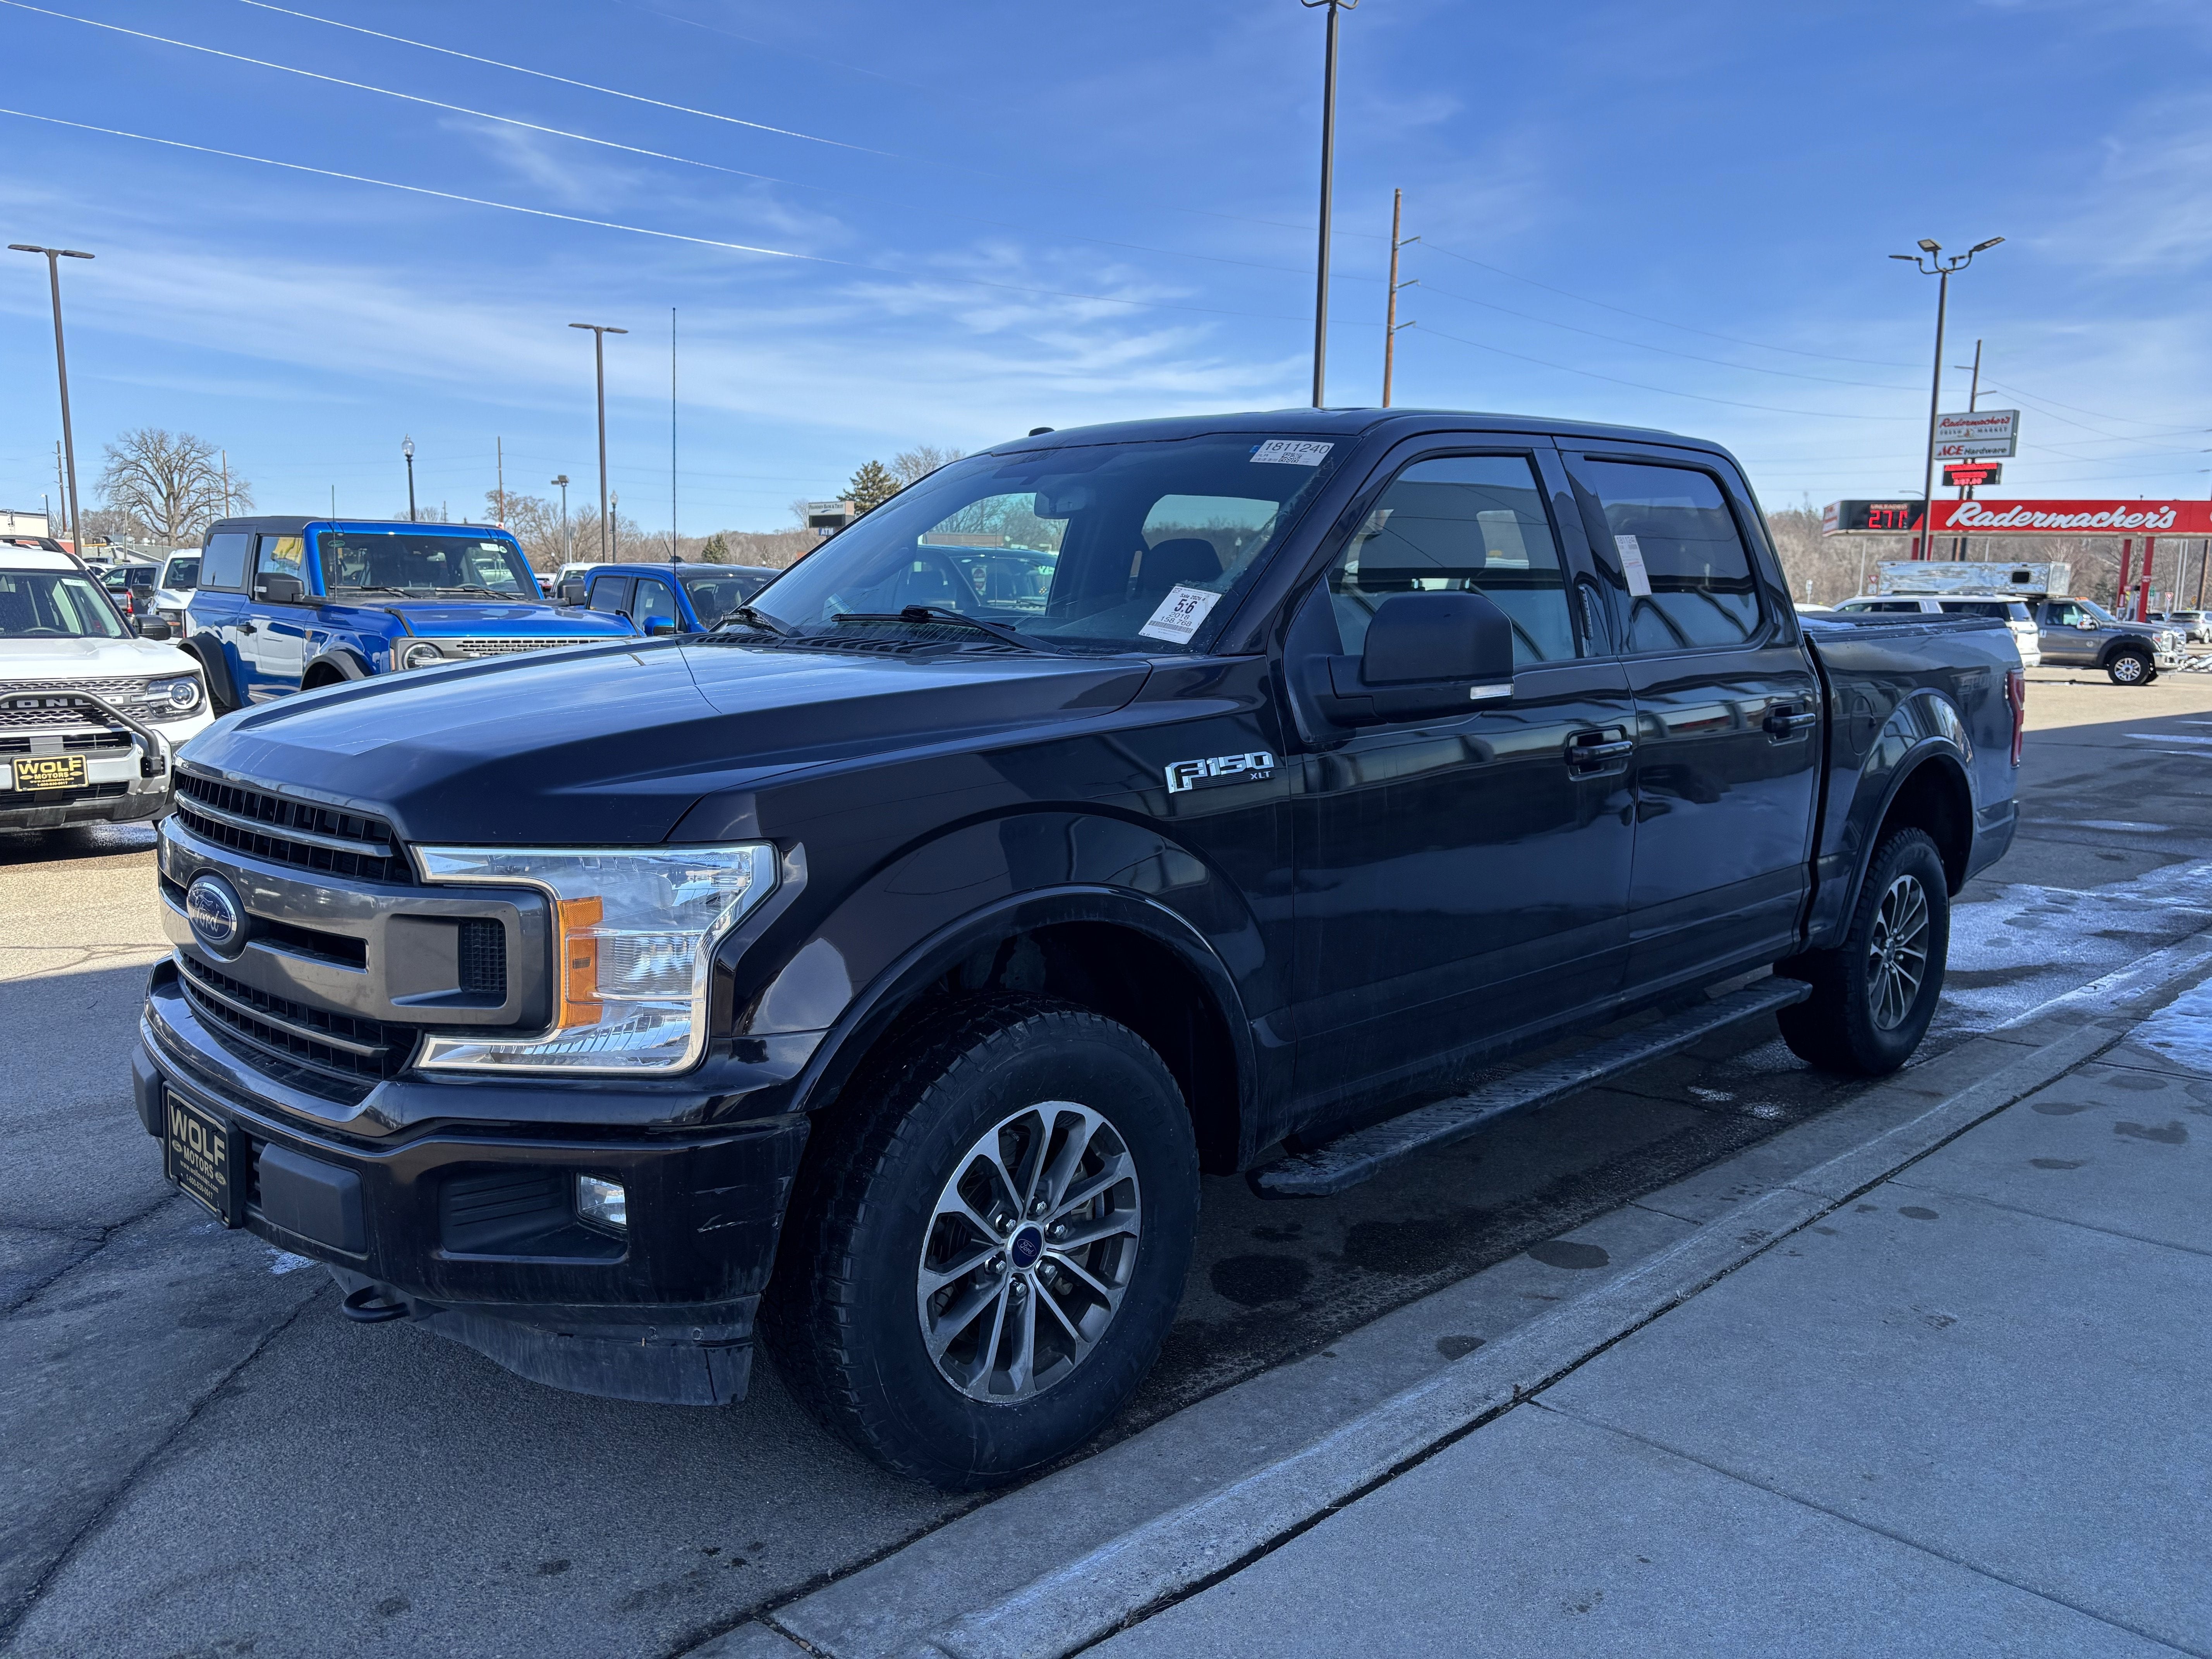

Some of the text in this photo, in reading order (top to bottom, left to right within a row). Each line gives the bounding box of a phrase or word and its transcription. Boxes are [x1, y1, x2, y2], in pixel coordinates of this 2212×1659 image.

[1265, 442, 1330, 454] 1811240
[1938, 445, 1964, 456] ACE
[1946, 501, 2176, 529] Radermacher's
[821, 527, 834, 535] ATM
[1169, 612, 1190, 620] 2018
[18, 760, 81, 775] WOLF
[1250, 771, 1271, 780] XLT
[193, 895, 219, 933] Ford
[170, 1105, 225, 1166] WOLF
[184, 1145, 213, 1179] MOTORS
[1020, 1241, 1034, 1255] Ford
